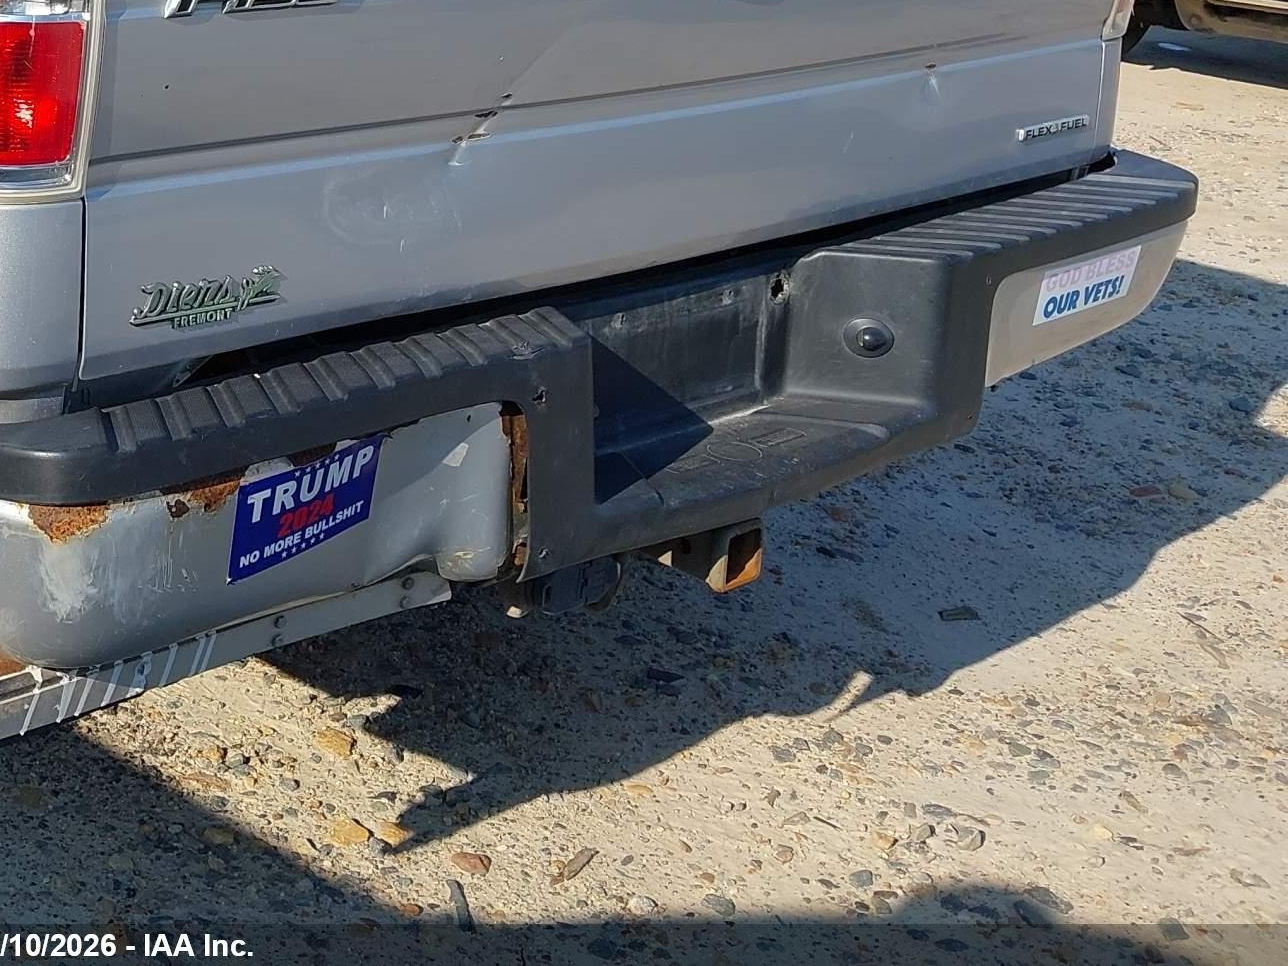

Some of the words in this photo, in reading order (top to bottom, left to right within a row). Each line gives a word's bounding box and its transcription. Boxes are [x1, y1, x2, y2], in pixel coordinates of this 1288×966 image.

[173, 307, 234, 329] FREMONT
[1043, 289, 1081, 319] OUR
[1083, 275, 1125, 306] VETS!
[247, 444, 375, 524] TRUMP
[239, 549, 261, 569] NO
[263, 531, 302, 559] MORE
[304, 499, 365, 540] BULLSHIT
[276, 492, 337, 539] 2024
